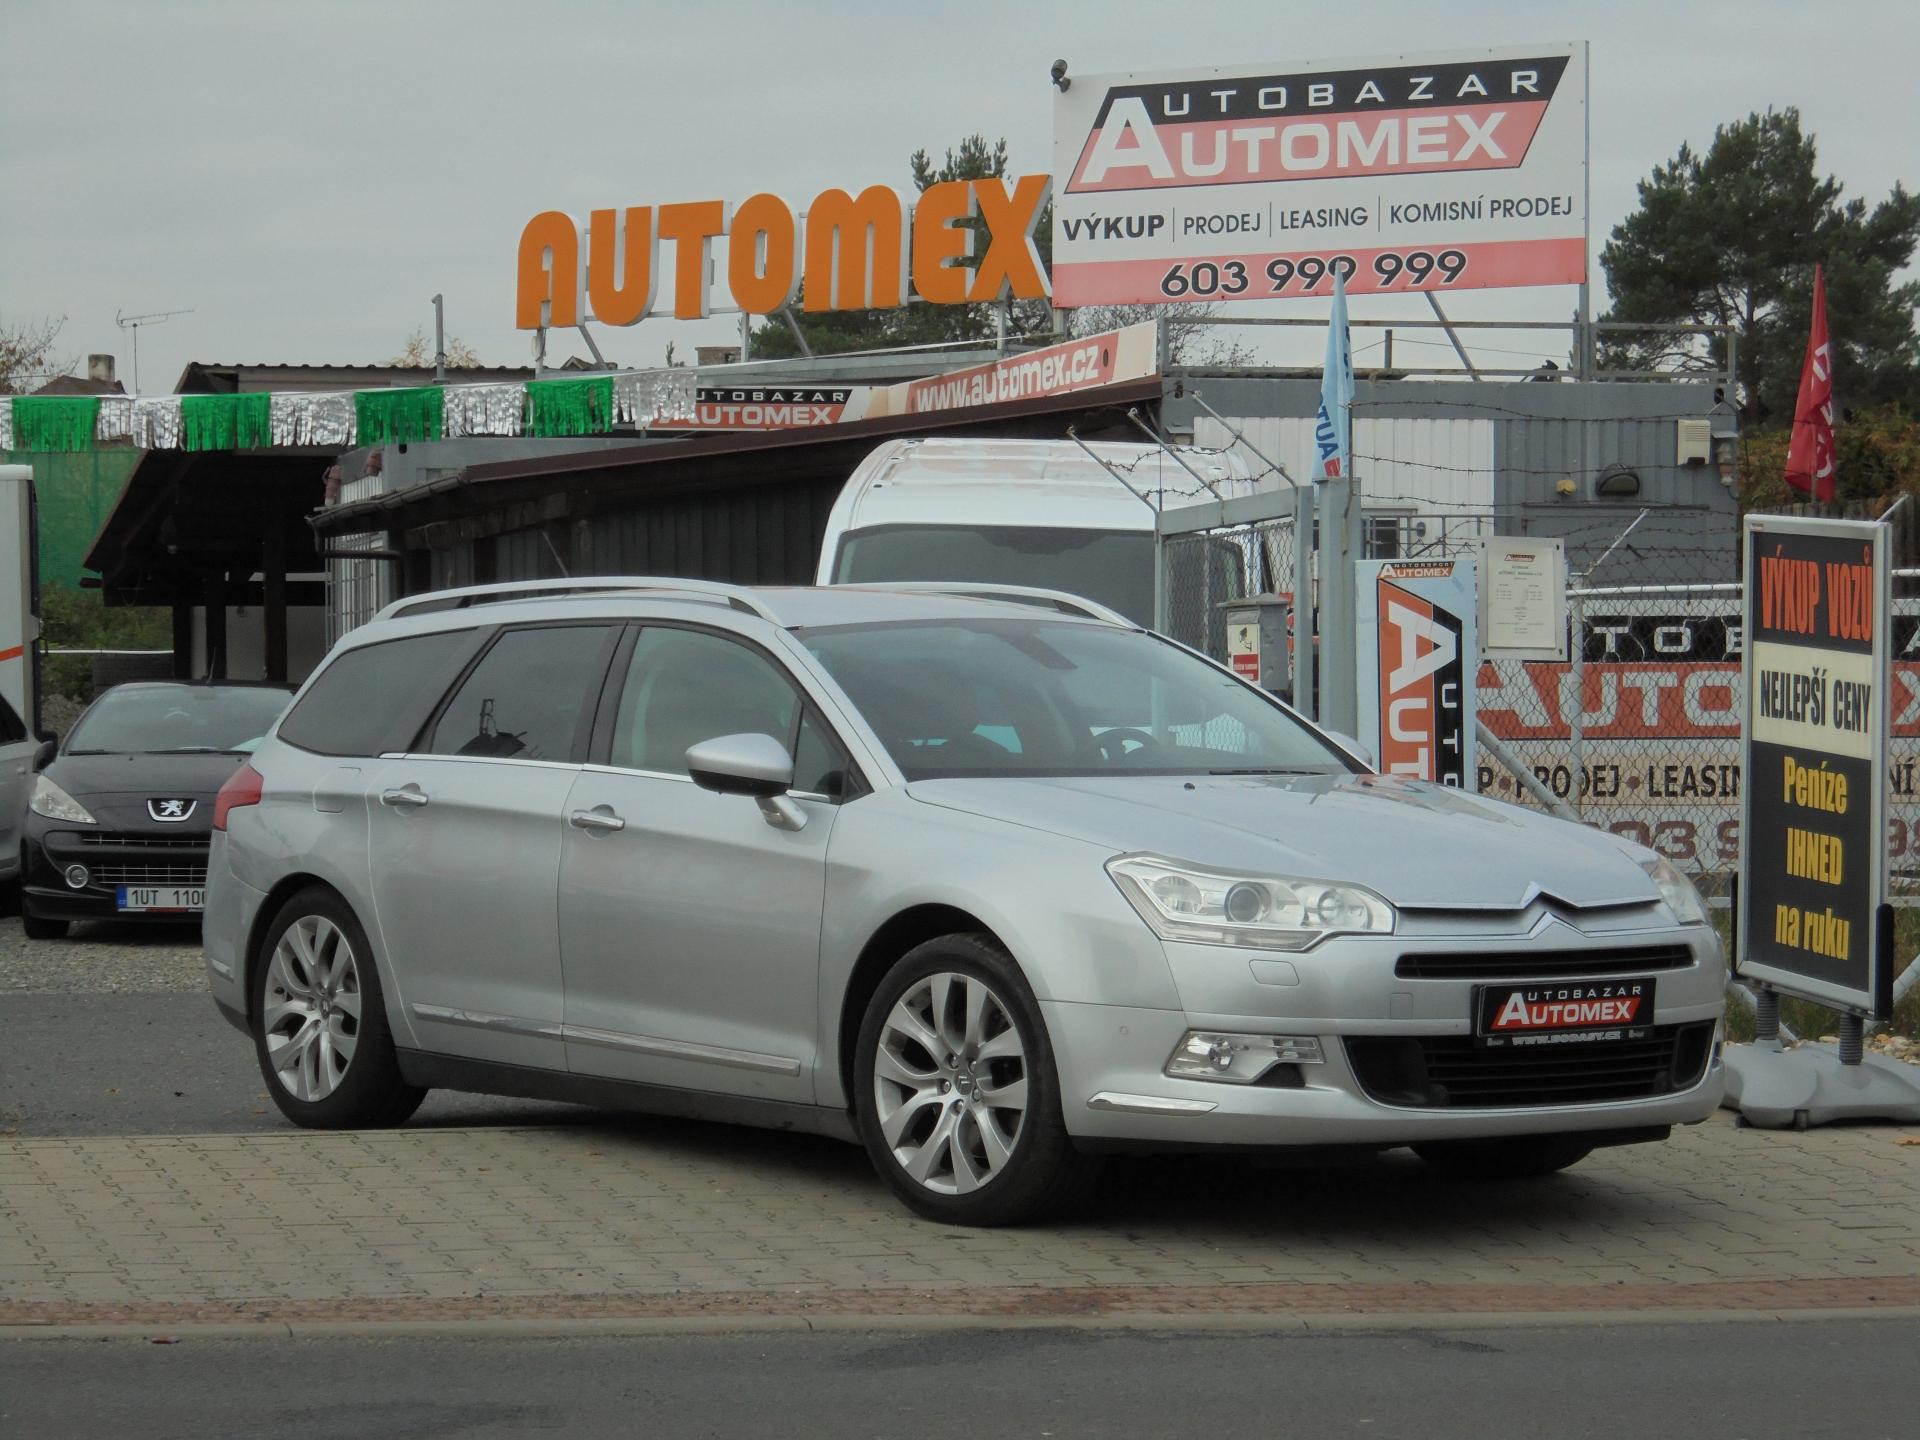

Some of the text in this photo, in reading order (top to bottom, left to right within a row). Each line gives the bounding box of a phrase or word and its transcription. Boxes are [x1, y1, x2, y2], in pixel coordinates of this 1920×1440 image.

[1079, 96, 1509, 184] AUTOMEX
[1062, 193, 1573, 242] VÝKUP PRODEJ LEASING KOMISNÍ PRODEJ
[515, 174, 1055, 331] AUTOMEX
[1159, 249, 1468, 298] 603 999 999
[916, 345, 1101, 412] www.automex.cz
[1380, 563, 1449, 578] AUTOMEX
[1760, 544, 1873, 642] VÝKUP VOZŮ
[1760, 666, 1828, 726] NEJLEPŠÍ
[1833, 679, 1871, 733] CENY
[1783, 756, 1848, 814] Peníze
[1786, 828, 1843, 885] IHNED
[131, 890, 158, 905] 1UT
[1775, 904, 1849, 960] na ruku
[1497, 992, 1631, 1026] AUTOMEX
